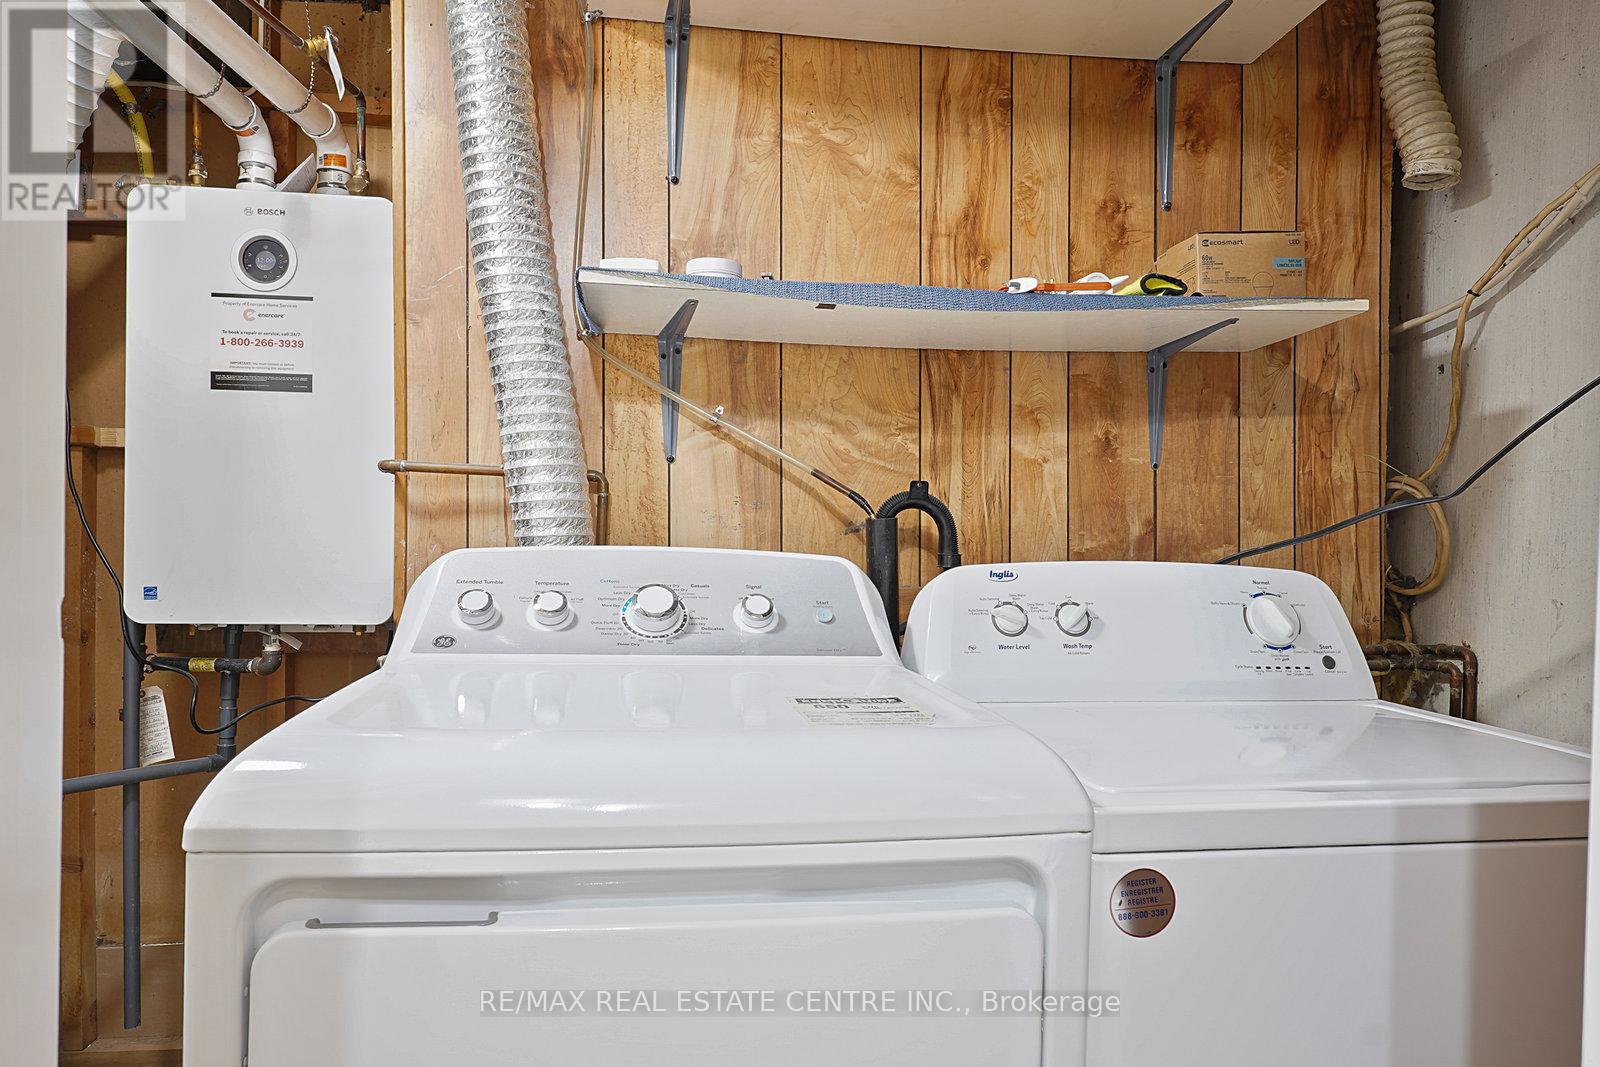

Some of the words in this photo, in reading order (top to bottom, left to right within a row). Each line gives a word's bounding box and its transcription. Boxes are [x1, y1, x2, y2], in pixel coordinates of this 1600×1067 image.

[257, 208, 286, 216] BOSCH
[220, 337, 304, 348] 1-800-266-3939
[989, 570, 1014, 580] Inglis
[1126, 877, 1157, 887] REGISTER
[1121, 886, 1164, 898] ENREGISTRER
[1127, 896, 1159, 906] REGISTRE
